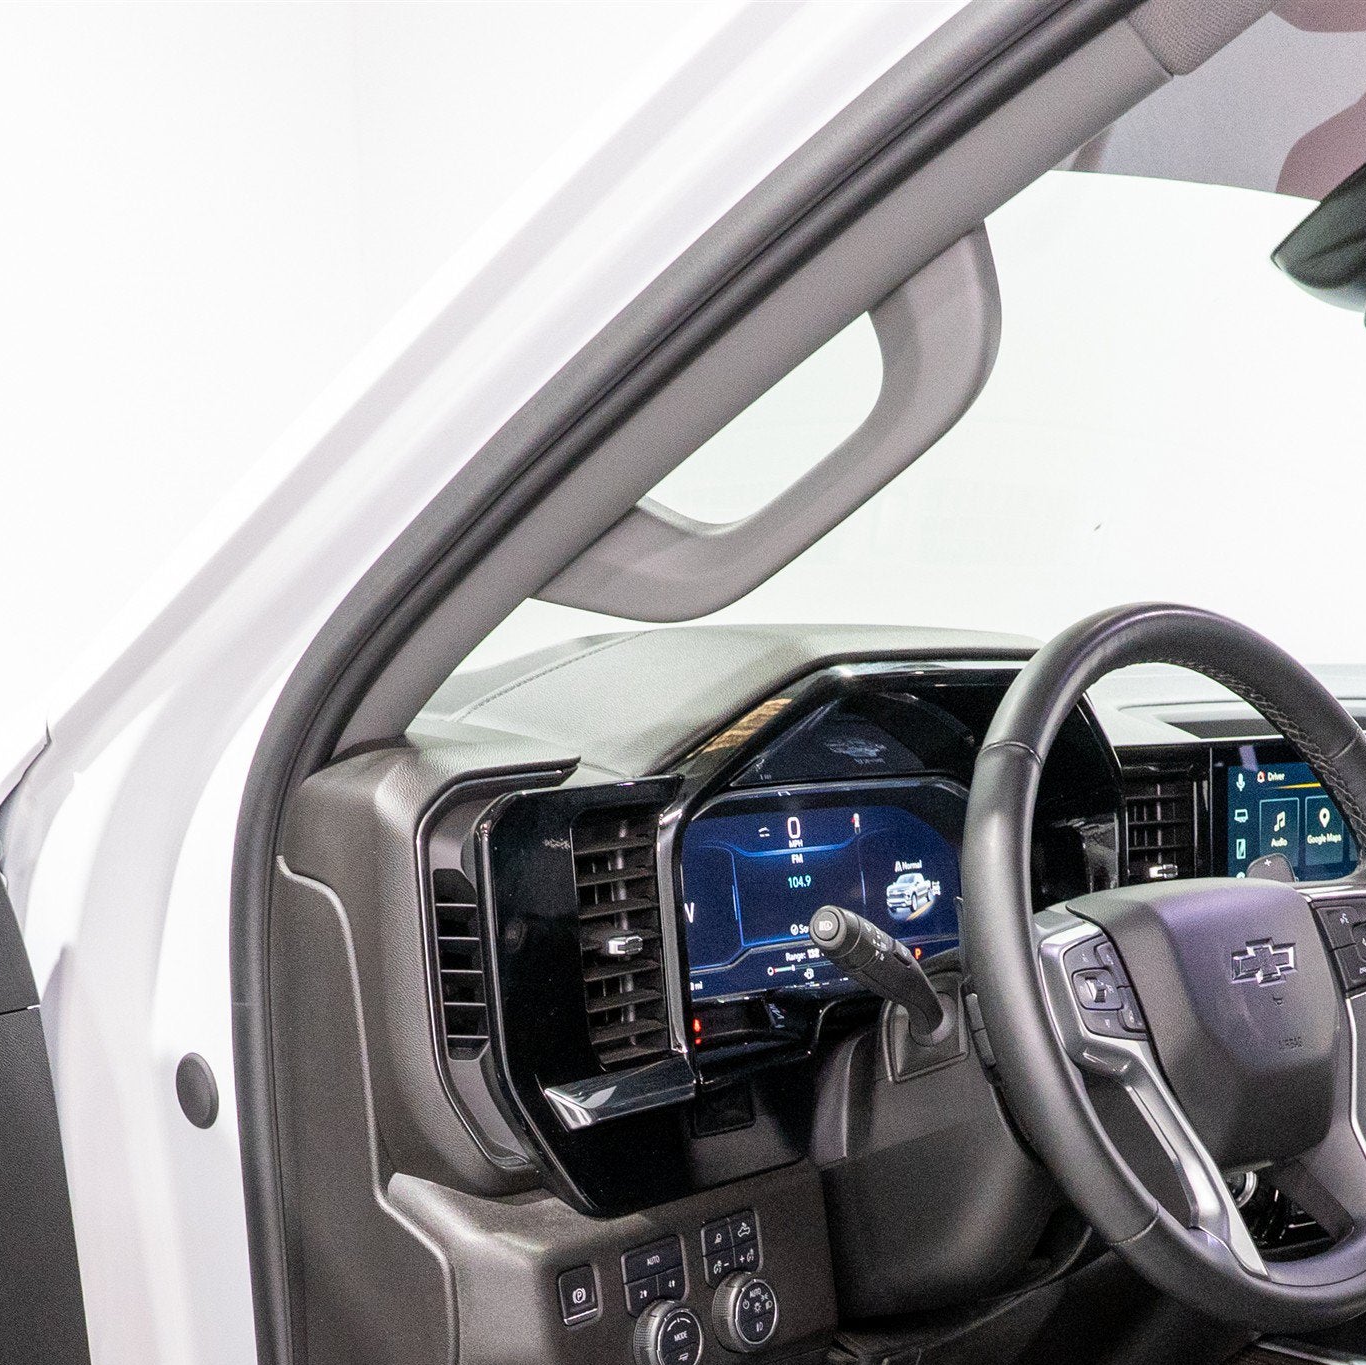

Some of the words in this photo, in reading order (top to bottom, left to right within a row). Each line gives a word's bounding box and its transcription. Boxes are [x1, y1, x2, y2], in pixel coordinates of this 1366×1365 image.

[1267, 772, 1285, 782] Driver
[787, 816, 801, 839] 0
[789, 839, 803, 848] MPH
[1271, 837, 1288, 848] Audio
[1307, 834, 1326, 846] Google
[1327, 832, 1342, 844] Maps
[791, 854, 803, 864] FM
[902, 860, 922, 870] Normal
[787, 874, 811, 888] 104.9
[785, 952, 806, 963] Range:
[914, 948, 921, 960] P
[647, 1255, 661, 1266] AUTO
[749, 1288, 761, 1298] AUTO
[674, 1330, 688, 1342] MODE
